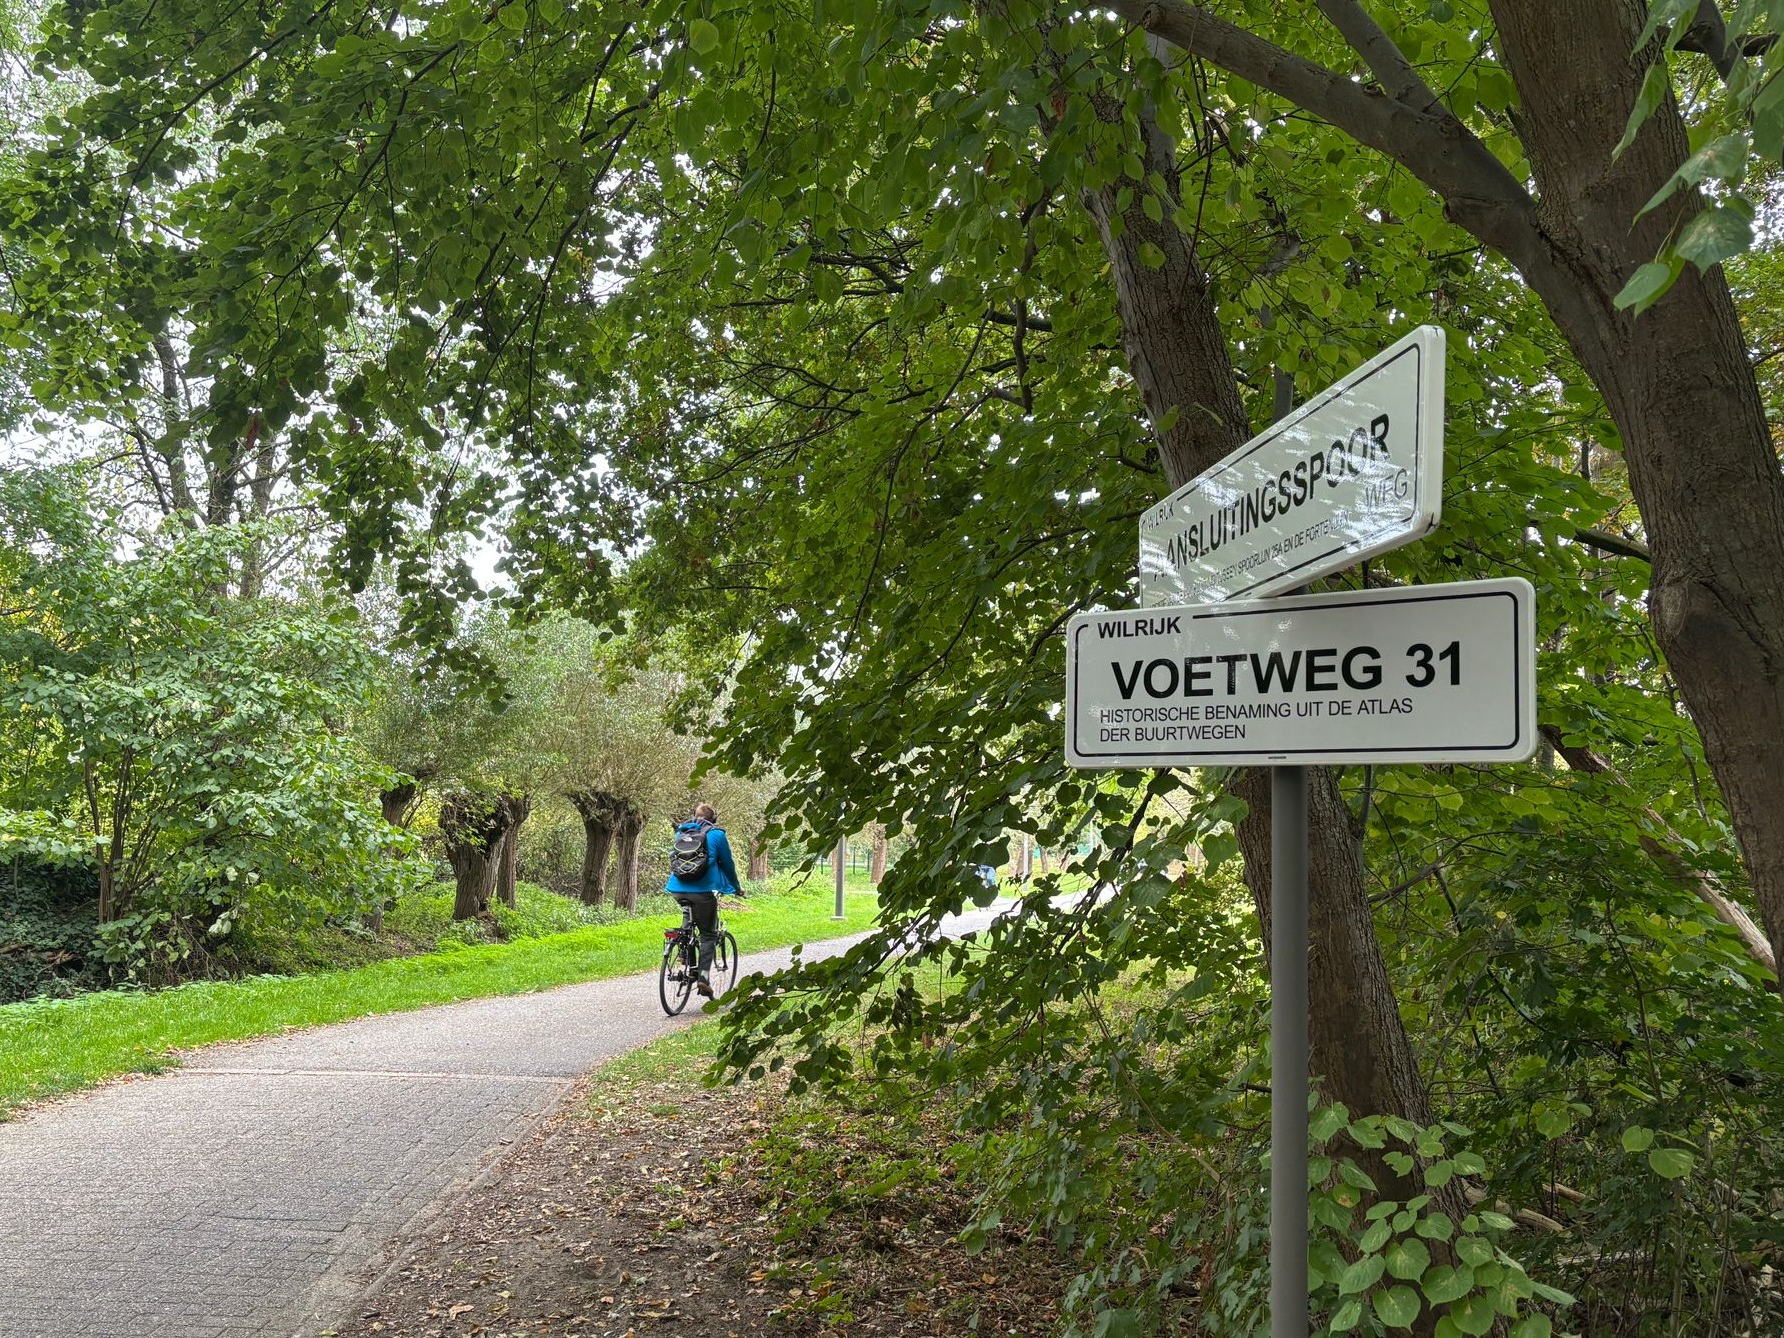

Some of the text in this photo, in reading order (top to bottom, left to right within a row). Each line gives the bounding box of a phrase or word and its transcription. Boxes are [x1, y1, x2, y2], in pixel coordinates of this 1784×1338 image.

[1153, 411, 1391, 583] ANSLUITINGSSPOOR
[1283, 536, 1294, 554] EN
[1294, 530, 1305, 549] DE
[1097, 616, 1182, 639] WILRIJK
[1111, 640, 1461, 700] VOETWEG 31
[1100, 697, 1413, 724] HISTORISCHE BENAMING UIT DE ATLAS
[1100, 724, 1246, 743] DER BUURTWEGEN
